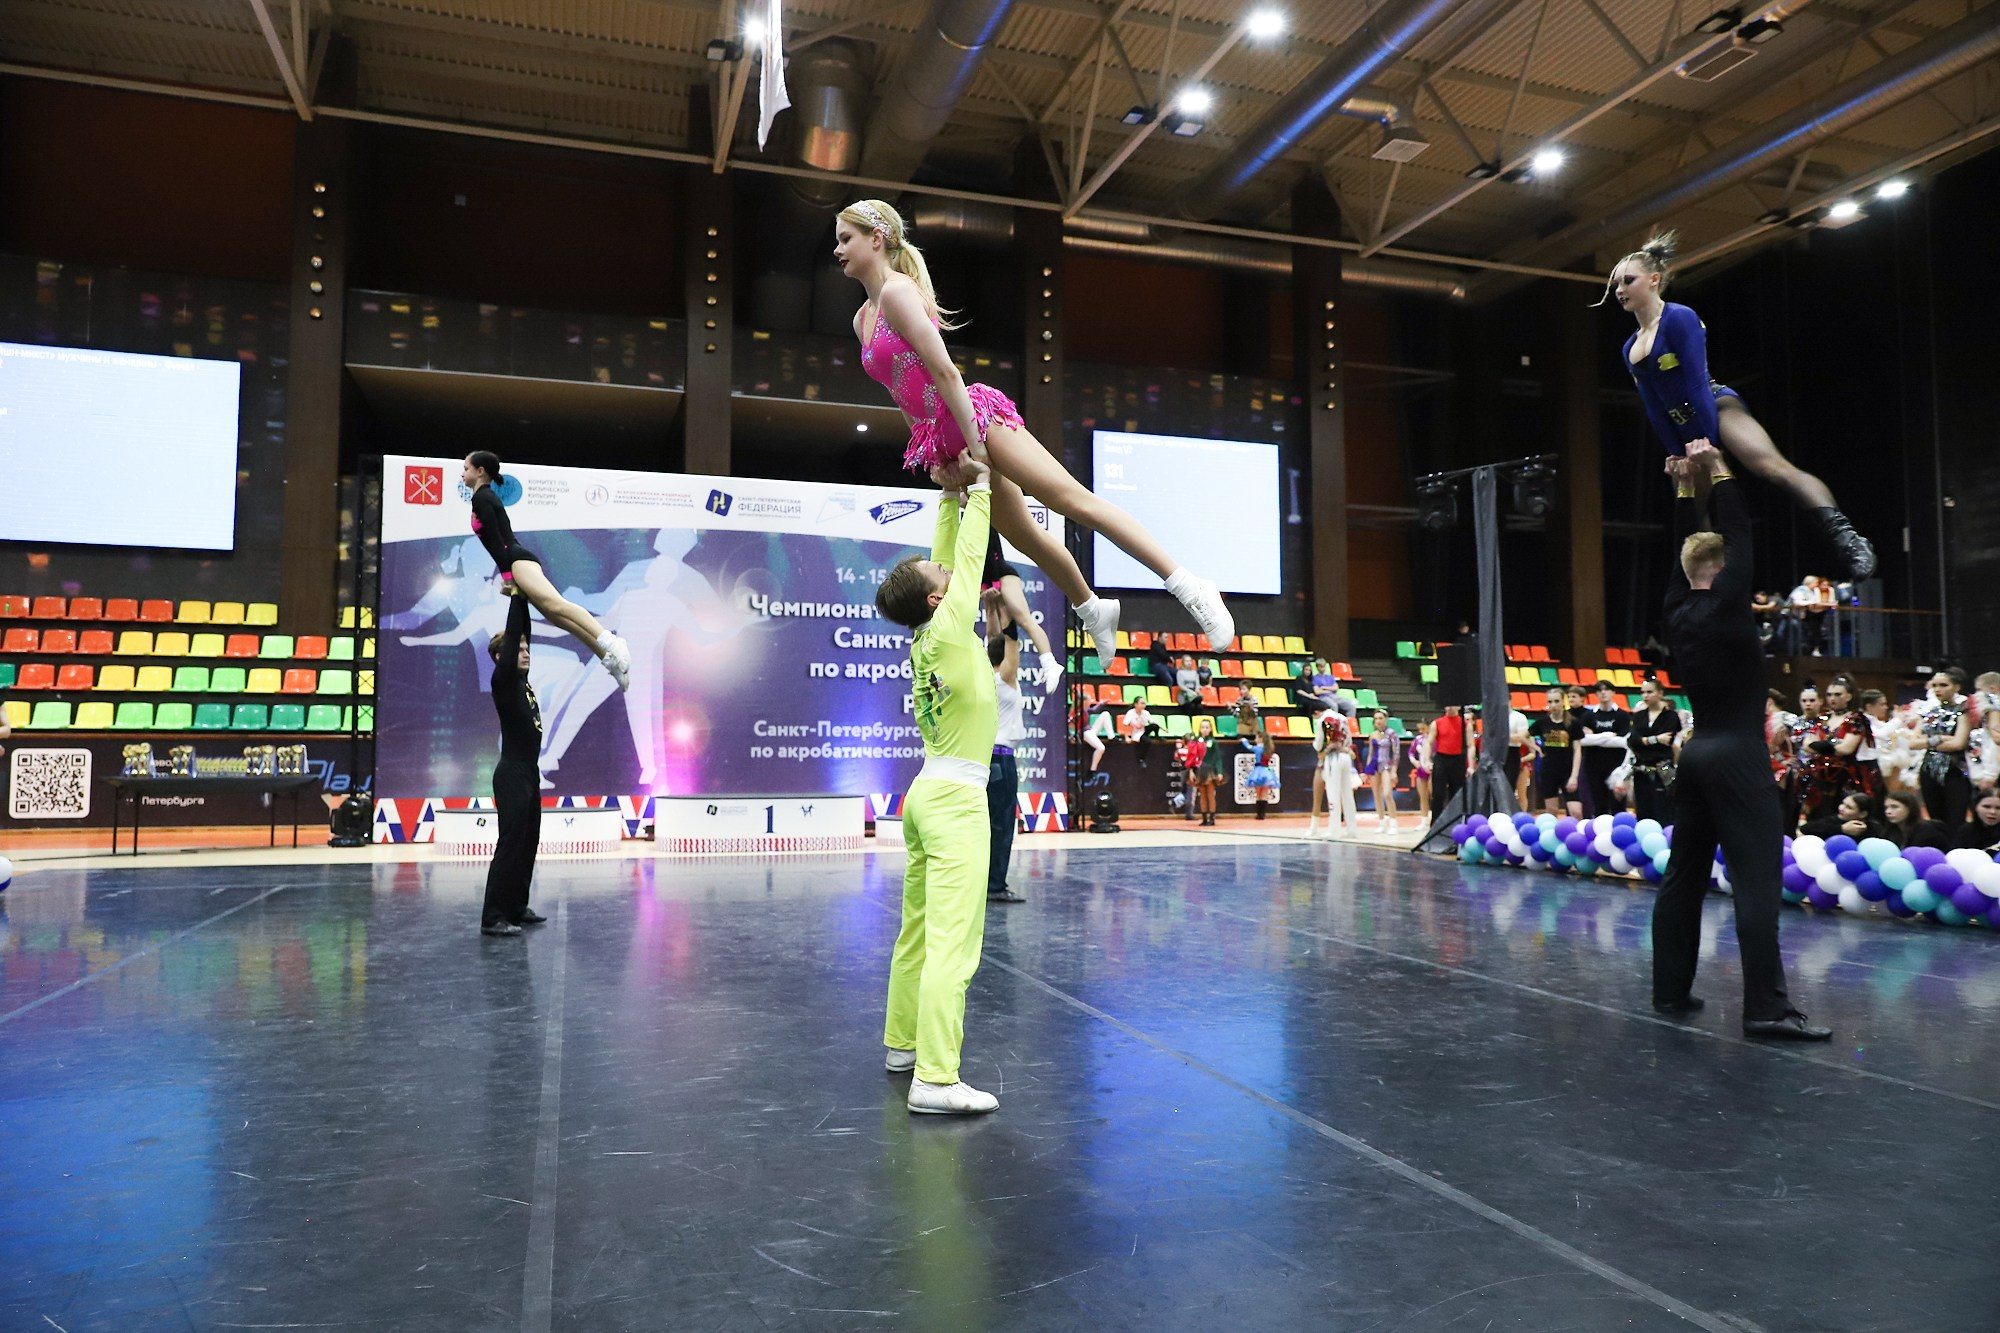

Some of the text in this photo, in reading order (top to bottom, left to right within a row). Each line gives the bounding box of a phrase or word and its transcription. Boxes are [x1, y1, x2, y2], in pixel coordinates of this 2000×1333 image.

[738, 503, 801, 514] ФЕДЕРАЦИЯ
[835, 567, 856, 584] 14
[869, 568, 887, 585] 15
[834, 626, 912, 649] Санкт-
[809, 662, 840, 678] по
[844, 658, 913, 684] акроб
[753, 719, 922, 742] Санкт-Петербургс
[750, 745, 774, 759] по
[778, 742, 925, 763] акробатическом
[141, 796, 205, 807] Петербурга
[763, 804, 775, 834] 1
